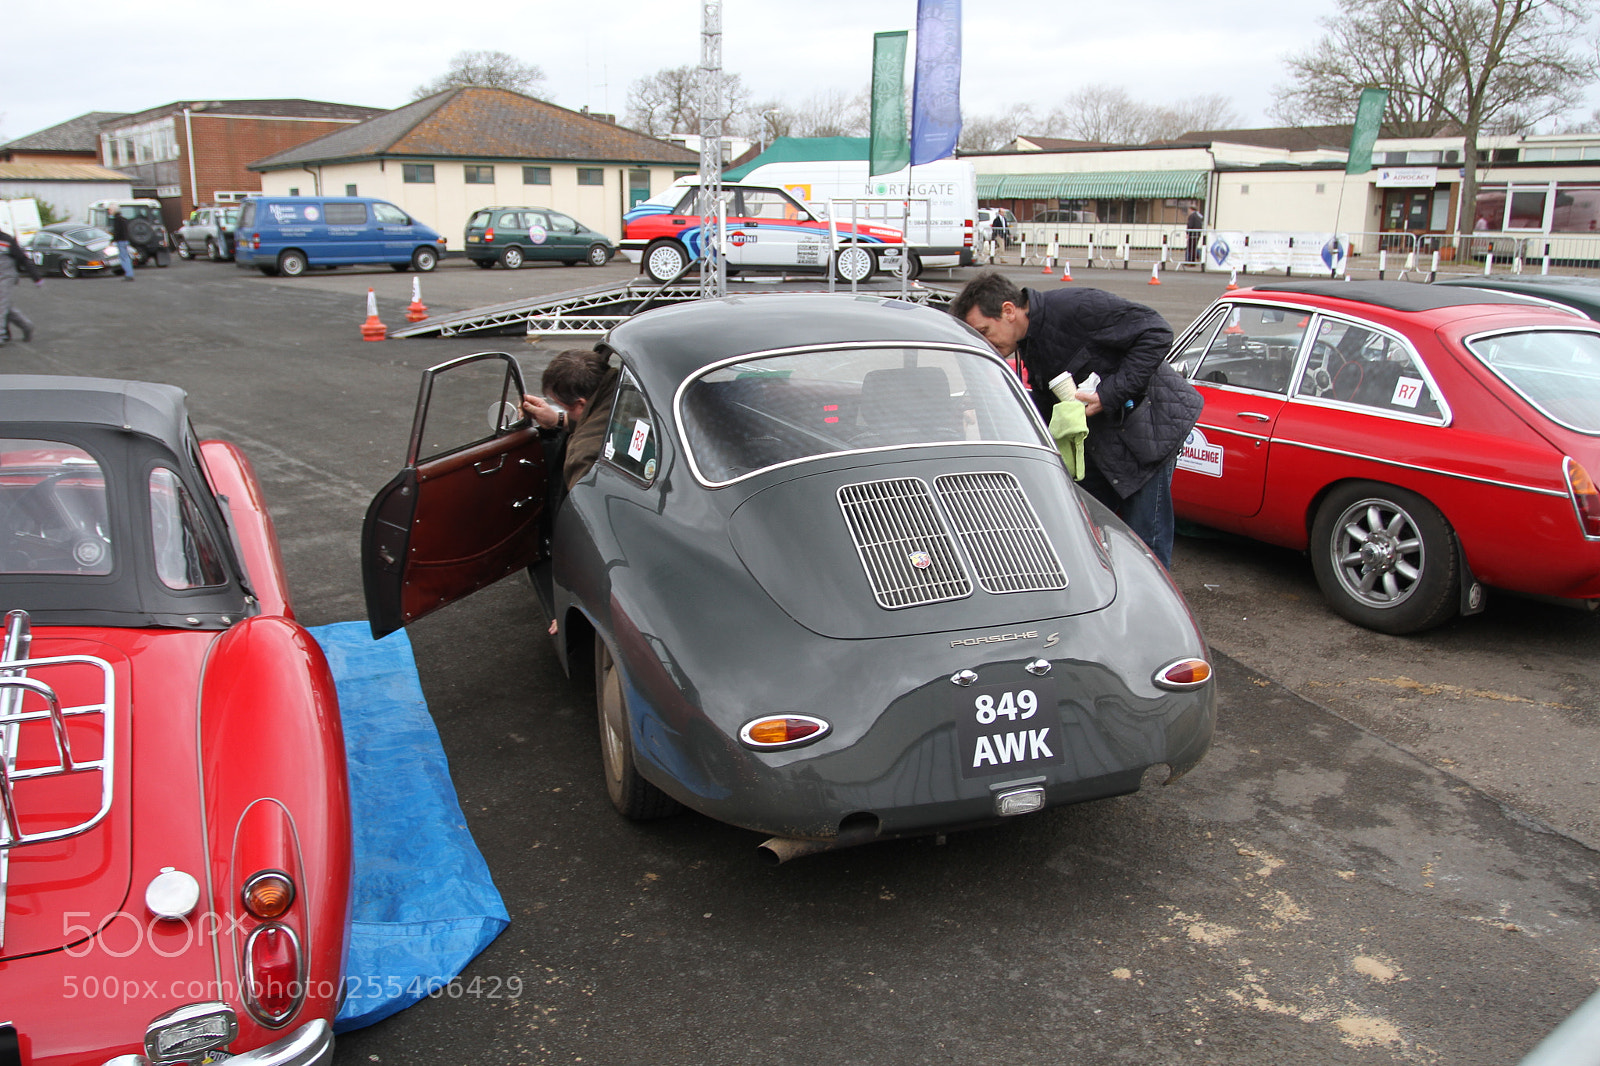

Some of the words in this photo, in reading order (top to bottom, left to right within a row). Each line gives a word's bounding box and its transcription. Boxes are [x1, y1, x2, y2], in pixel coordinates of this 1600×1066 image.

[865, 183, 954, 196] NORTHGATE
[725, 234, 758, 243] ARTINI
[1398, 384, 1417, 401] R7
[632, 430, 645, 452] R3
[949, 630, 1039, 648] PORSCHE
[1043, 632, 1061, 648] S
[974, 689, 1039, 725] 849
[972, 727, 1054, 768] AWK
